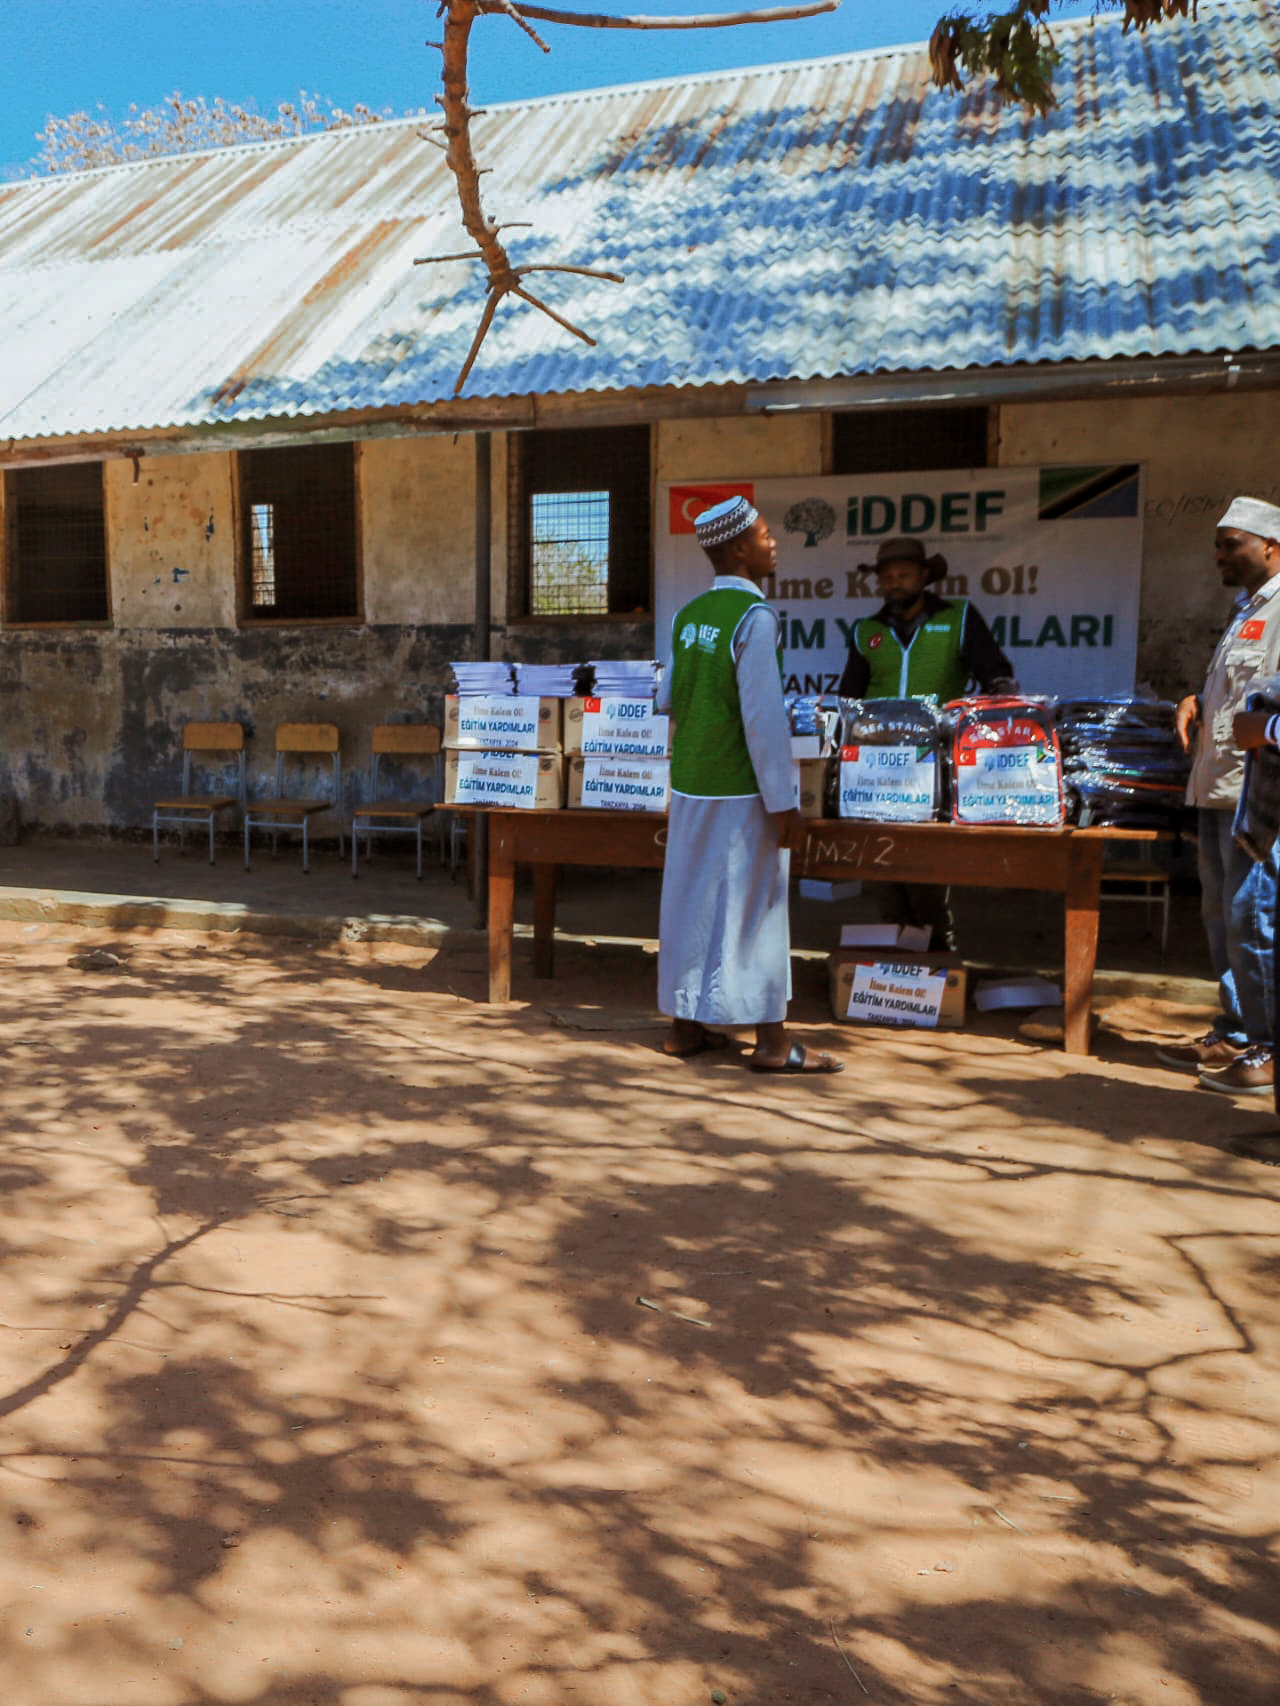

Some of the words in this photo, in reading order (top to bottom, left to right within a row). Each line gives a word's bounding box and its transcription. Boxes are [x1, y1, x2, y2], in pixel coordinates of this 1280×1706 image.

[846, 489, 1006, 536] iDDEF
[757, 571, 834, 600] lme
[981, 565, 1038, 596] Ol!
[618, 703, 647, 718] iDDEF
[461, 716, 487, 731] EĞİTİM
[488, 720, 536, 734] YARDIMLARI
[584, 739, 612, 753] EĞİTİM
[614, 742, 665, 756] YARDIMLARI
[878, 752, 910, 767] iDDEF
[459, 776, 485, 792] EĞİTİM
[486, 781, 534, 796] YARDIMLARI
[585, 778, 613, 793] EĞİTİM
[615, 783, 664, 798] YARDIMLARI
[874, 791, 930, 805] YARDIMLARI
[852, 990, 883, 1007] EĞİTİM
[884, 997, 937, 1017] YARDIMLARI
